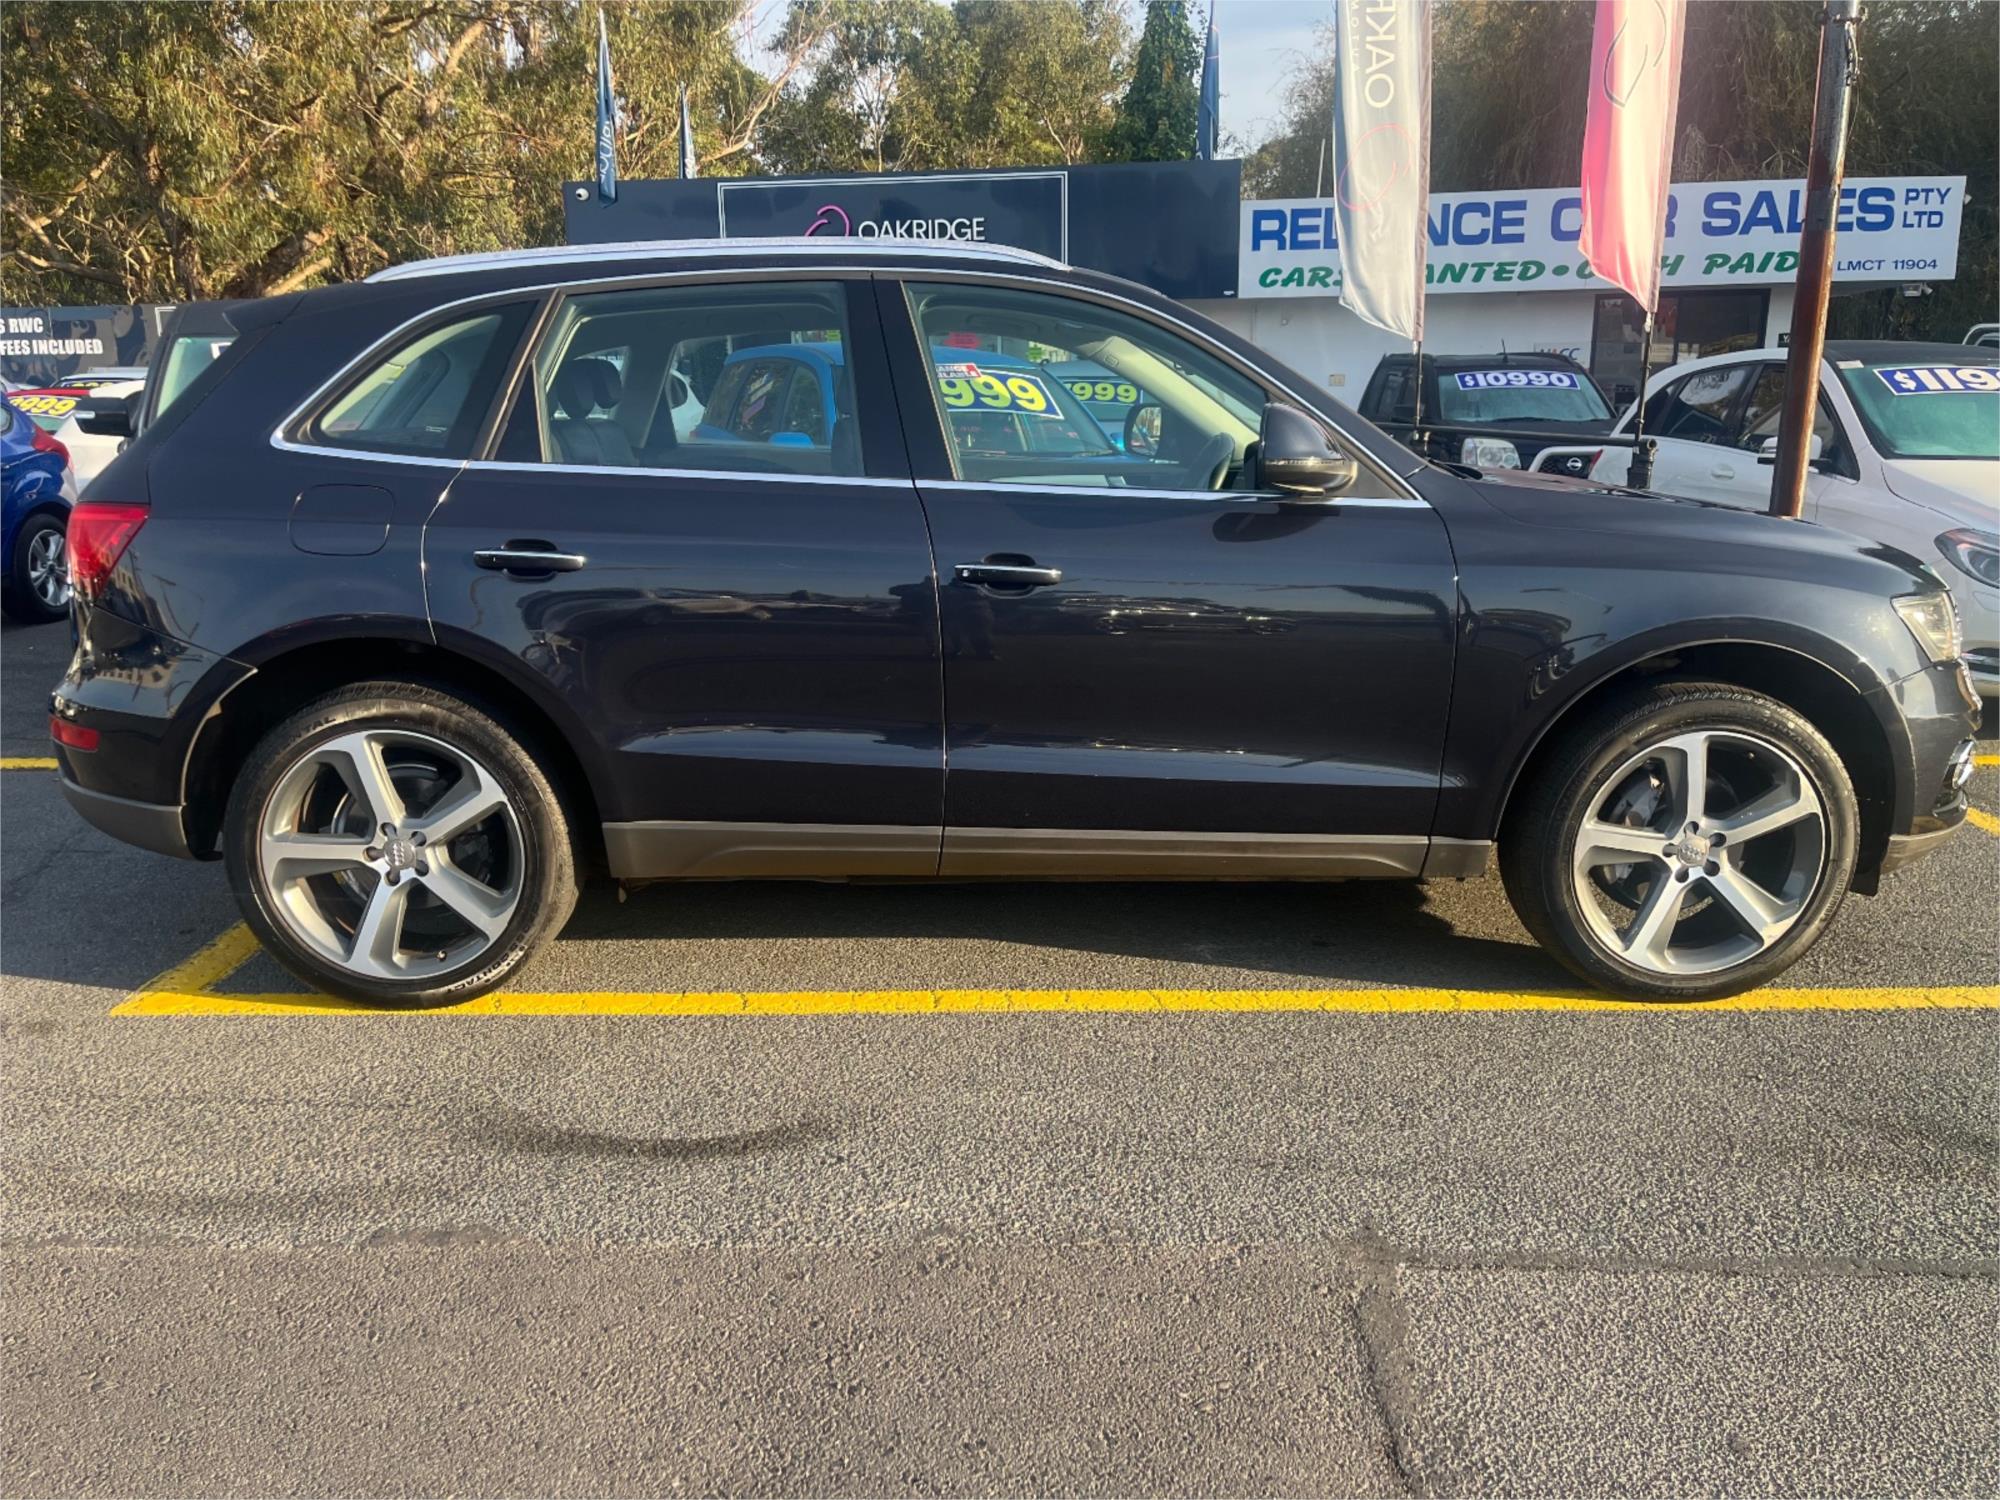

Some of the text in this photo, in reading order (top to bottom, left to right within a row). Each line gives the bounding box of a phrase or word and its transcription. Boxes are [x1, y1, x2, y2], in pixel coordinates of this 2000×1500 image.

[1904, 187, 1951, 206] PTY
[858, 217, 986, 241] OAKRIDGE
[1252, 200, 1528, 251] RELNCE
[1902, 211, 1944, 229] LTD
[1702, 251, 1800, 275] PAID
[1837, 259, 1938, 272] LMCT 11904
[8, 317, 44, 333] RWC
[0, 339, 104, 355] FEES INCLUDED
[1464, 372, 1572, 387] $10990
